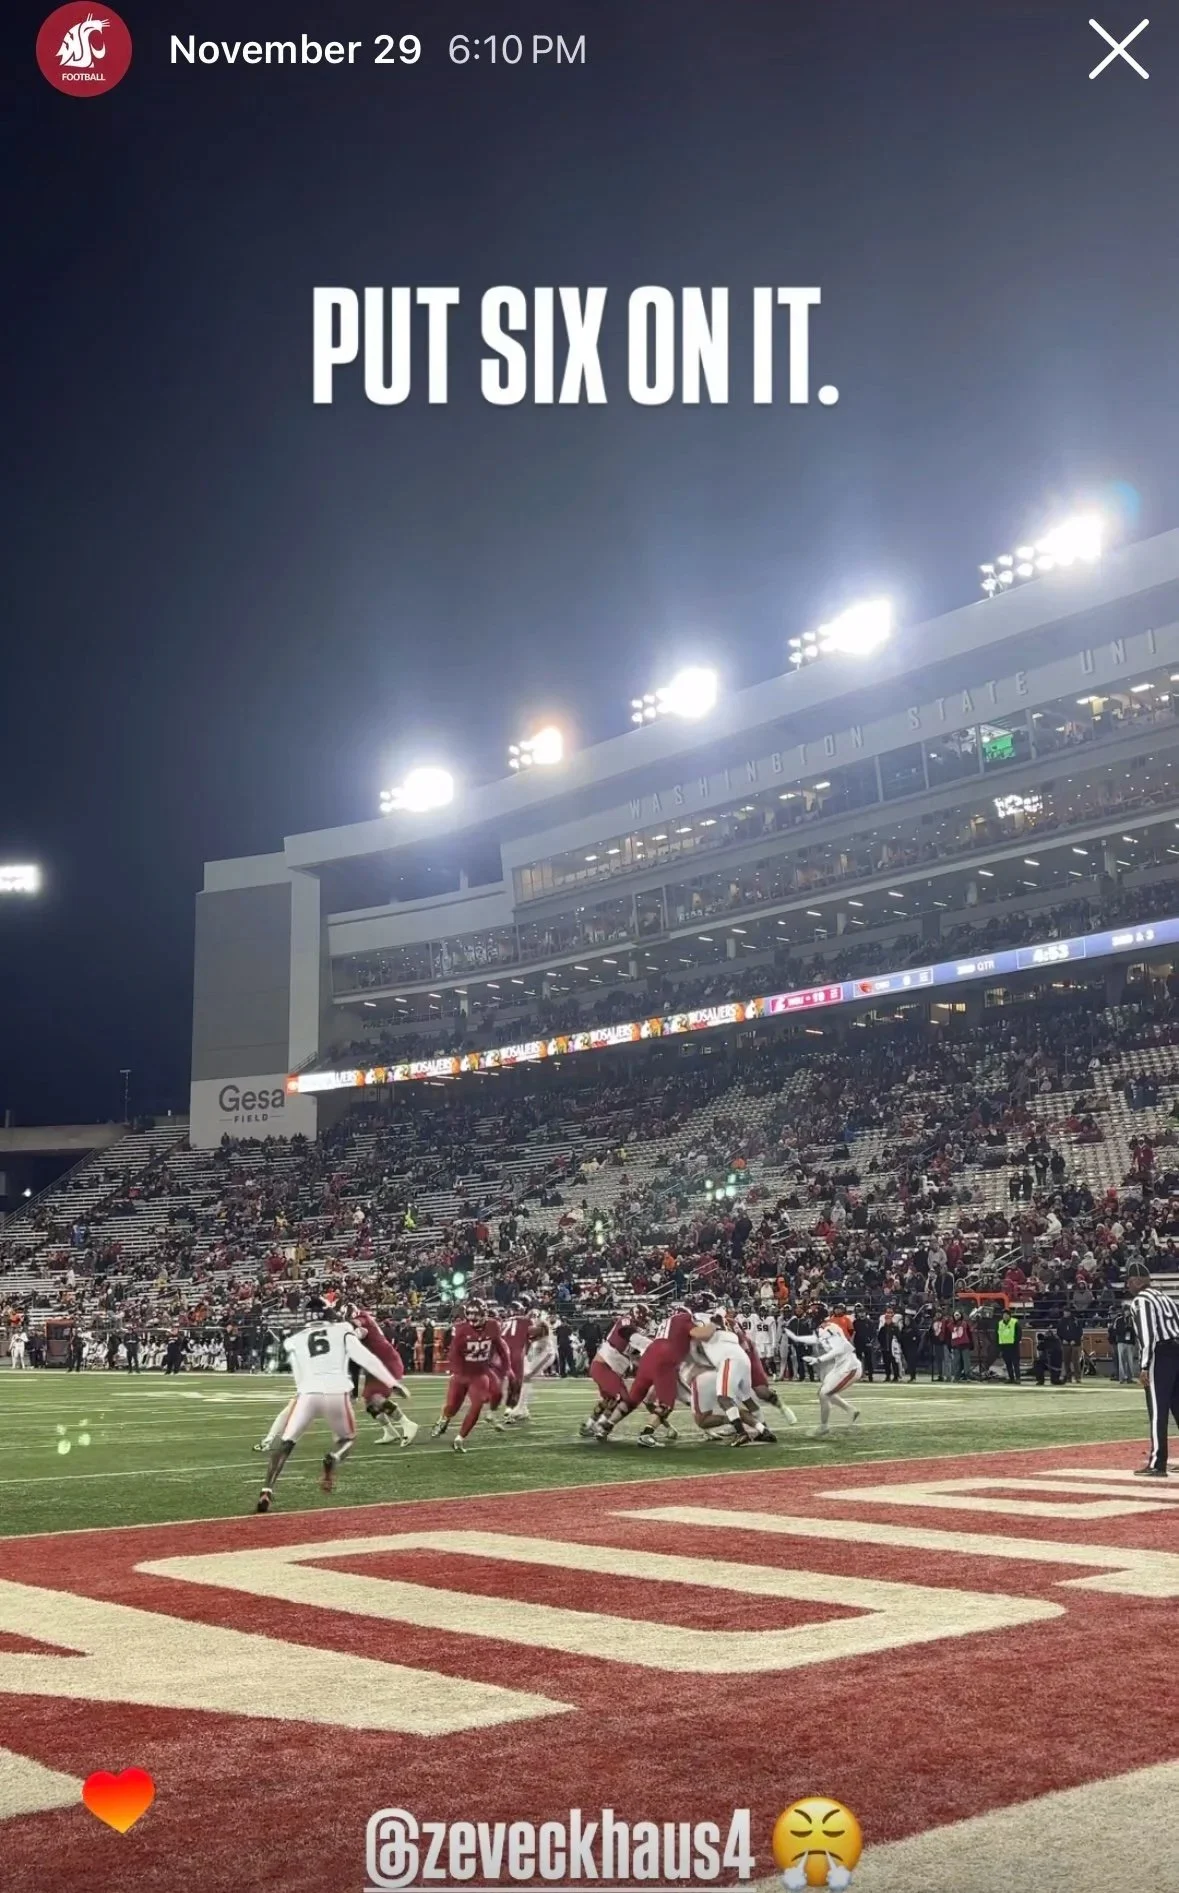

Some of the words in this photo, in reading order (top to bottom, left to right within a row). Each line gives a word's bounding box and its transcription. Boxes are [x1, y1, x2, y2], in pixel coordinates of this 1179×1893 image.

[627, 725, 865, 821] WASHINGTON
[907, 671, 1029, 731] STATE
[1080, 628, 1157, 675] UNI
[219, 1084, 285, 1112] Gesa
[233, 1113, 269, 1123] FIELD
[308, 1329, 330, 1358] 6
